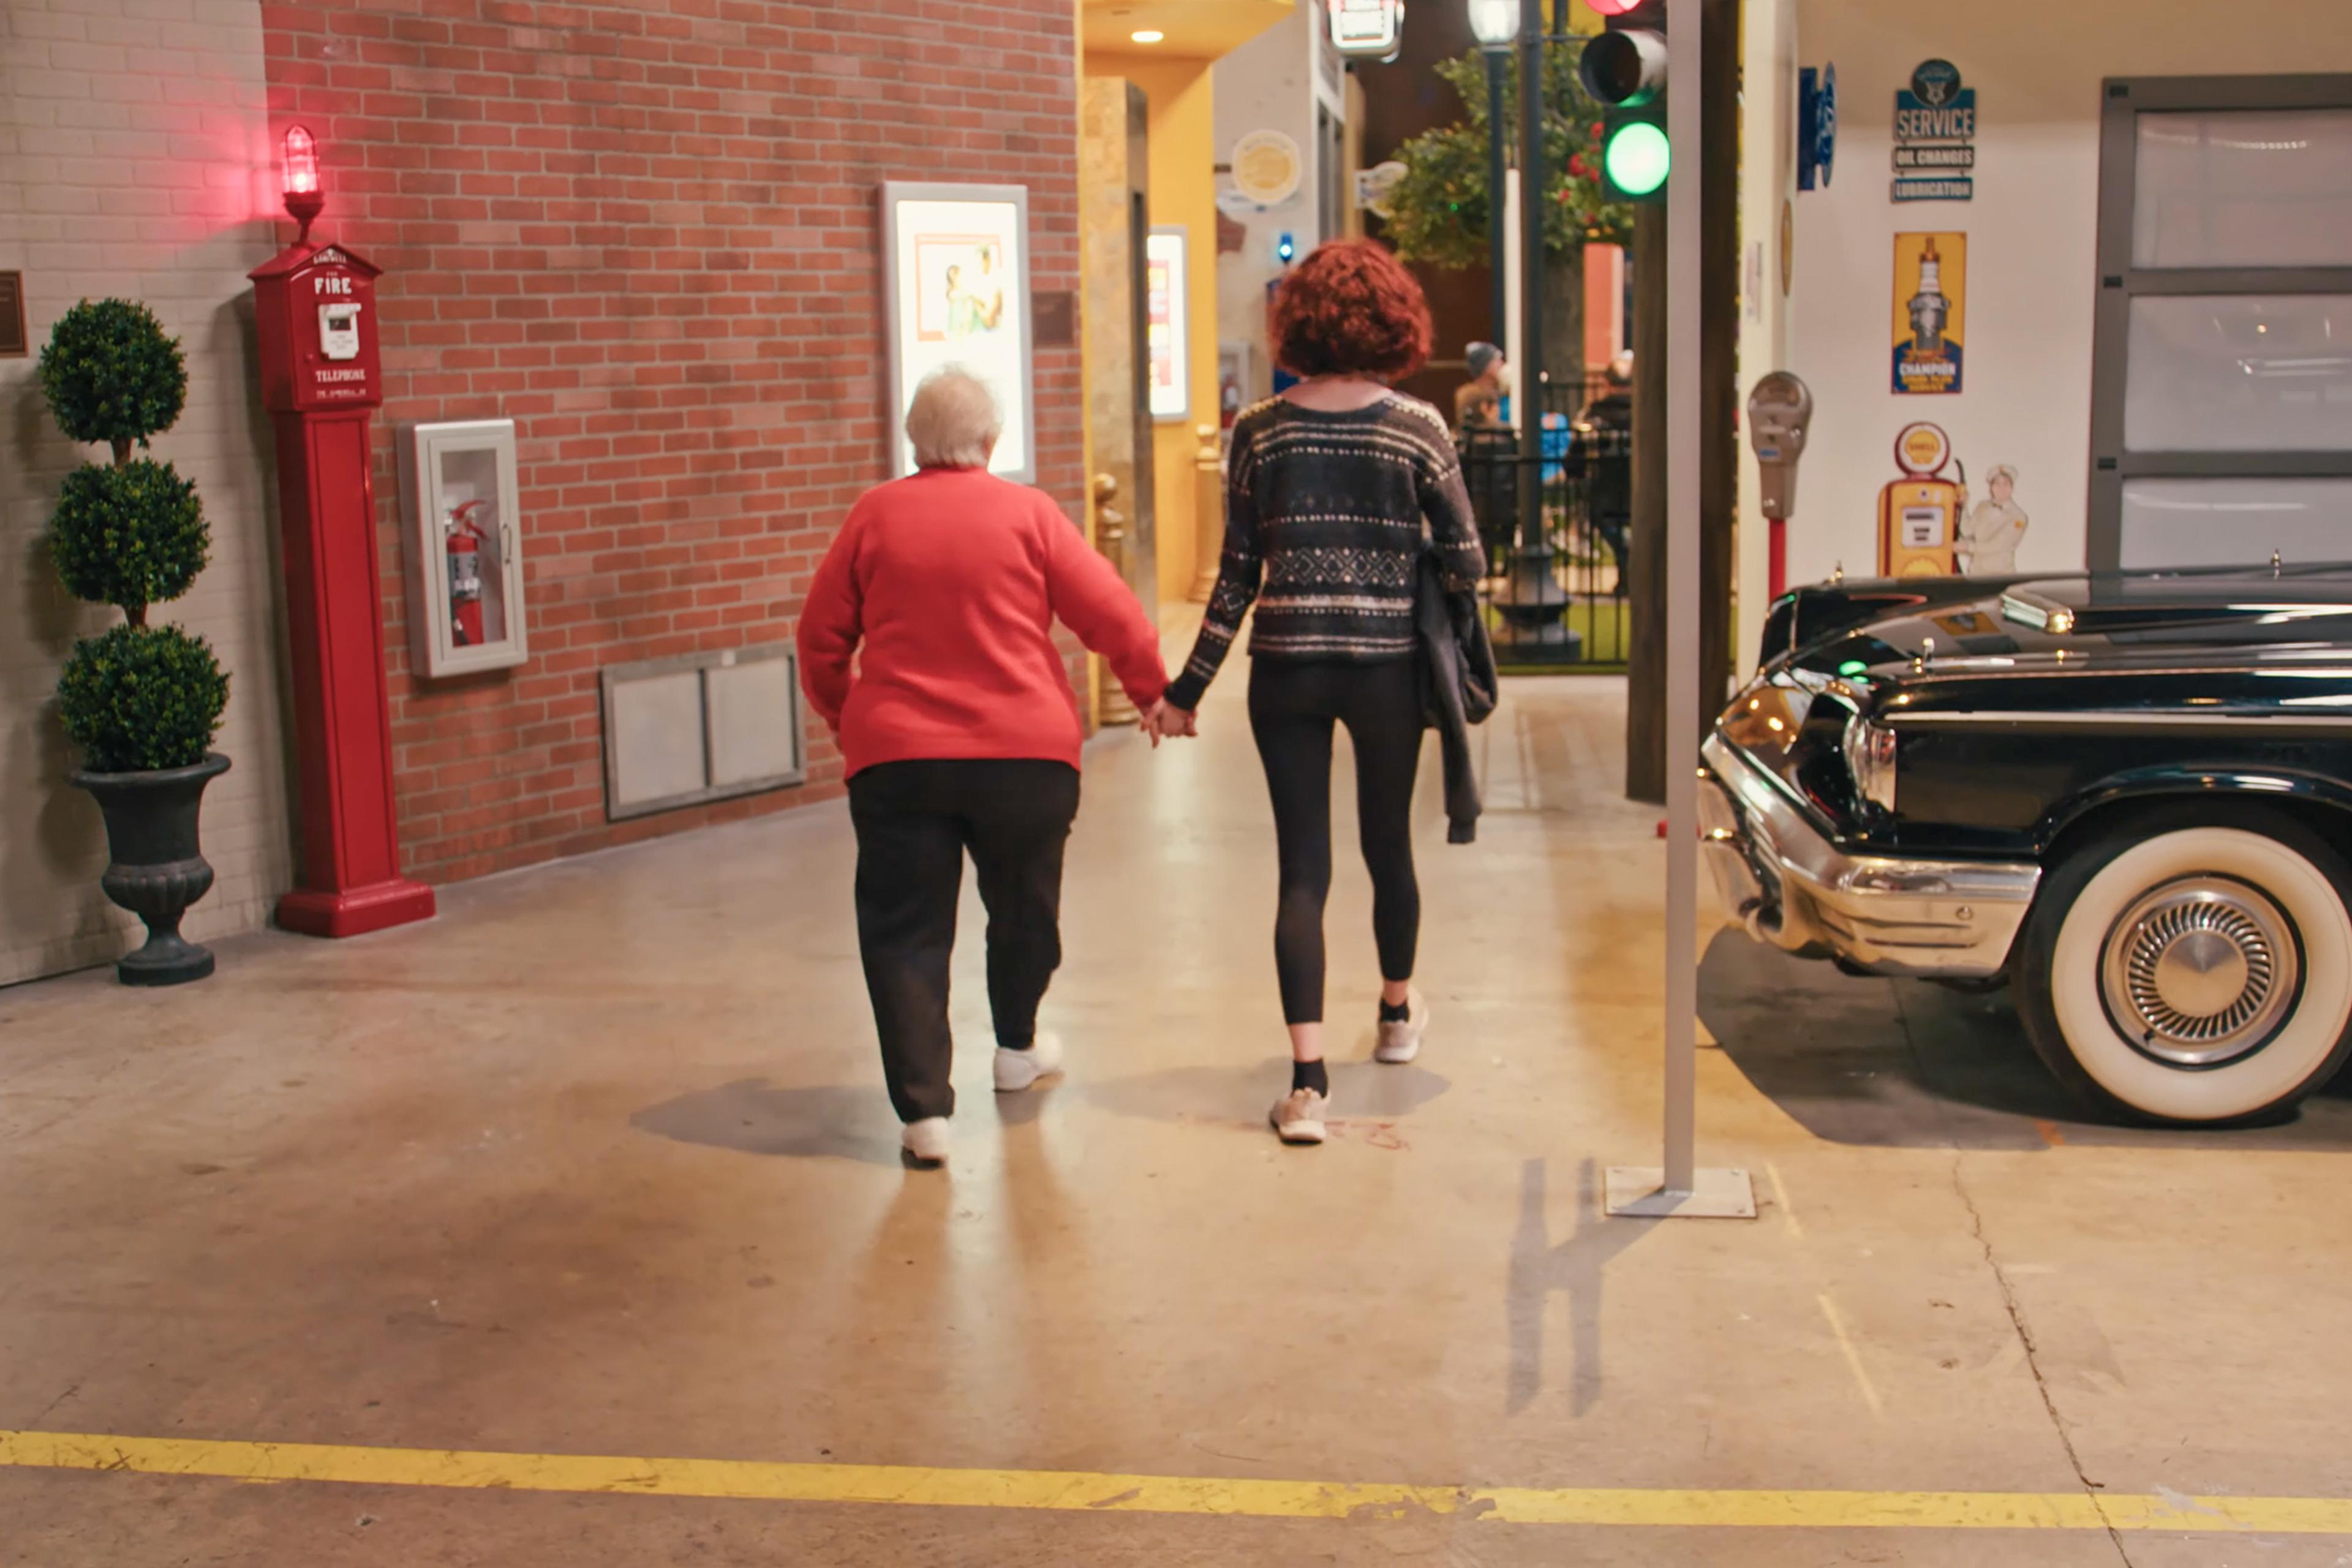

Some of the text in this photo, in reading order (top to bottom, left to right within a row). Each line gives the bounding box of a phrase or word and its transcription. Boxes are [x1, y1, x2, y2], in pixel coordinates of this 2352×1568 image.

[1898, 108, 1973, 137] SERVICE
[1897, 148, 1972, 165] OIL CHANGES
[1896, 182, 1970, 197] LUBRICATION
[314, 277, 352, 295] FIRE
[315, 369, 366, 383] TELEPHONE
[1899, 362, 1956, 376] CHAMPION
